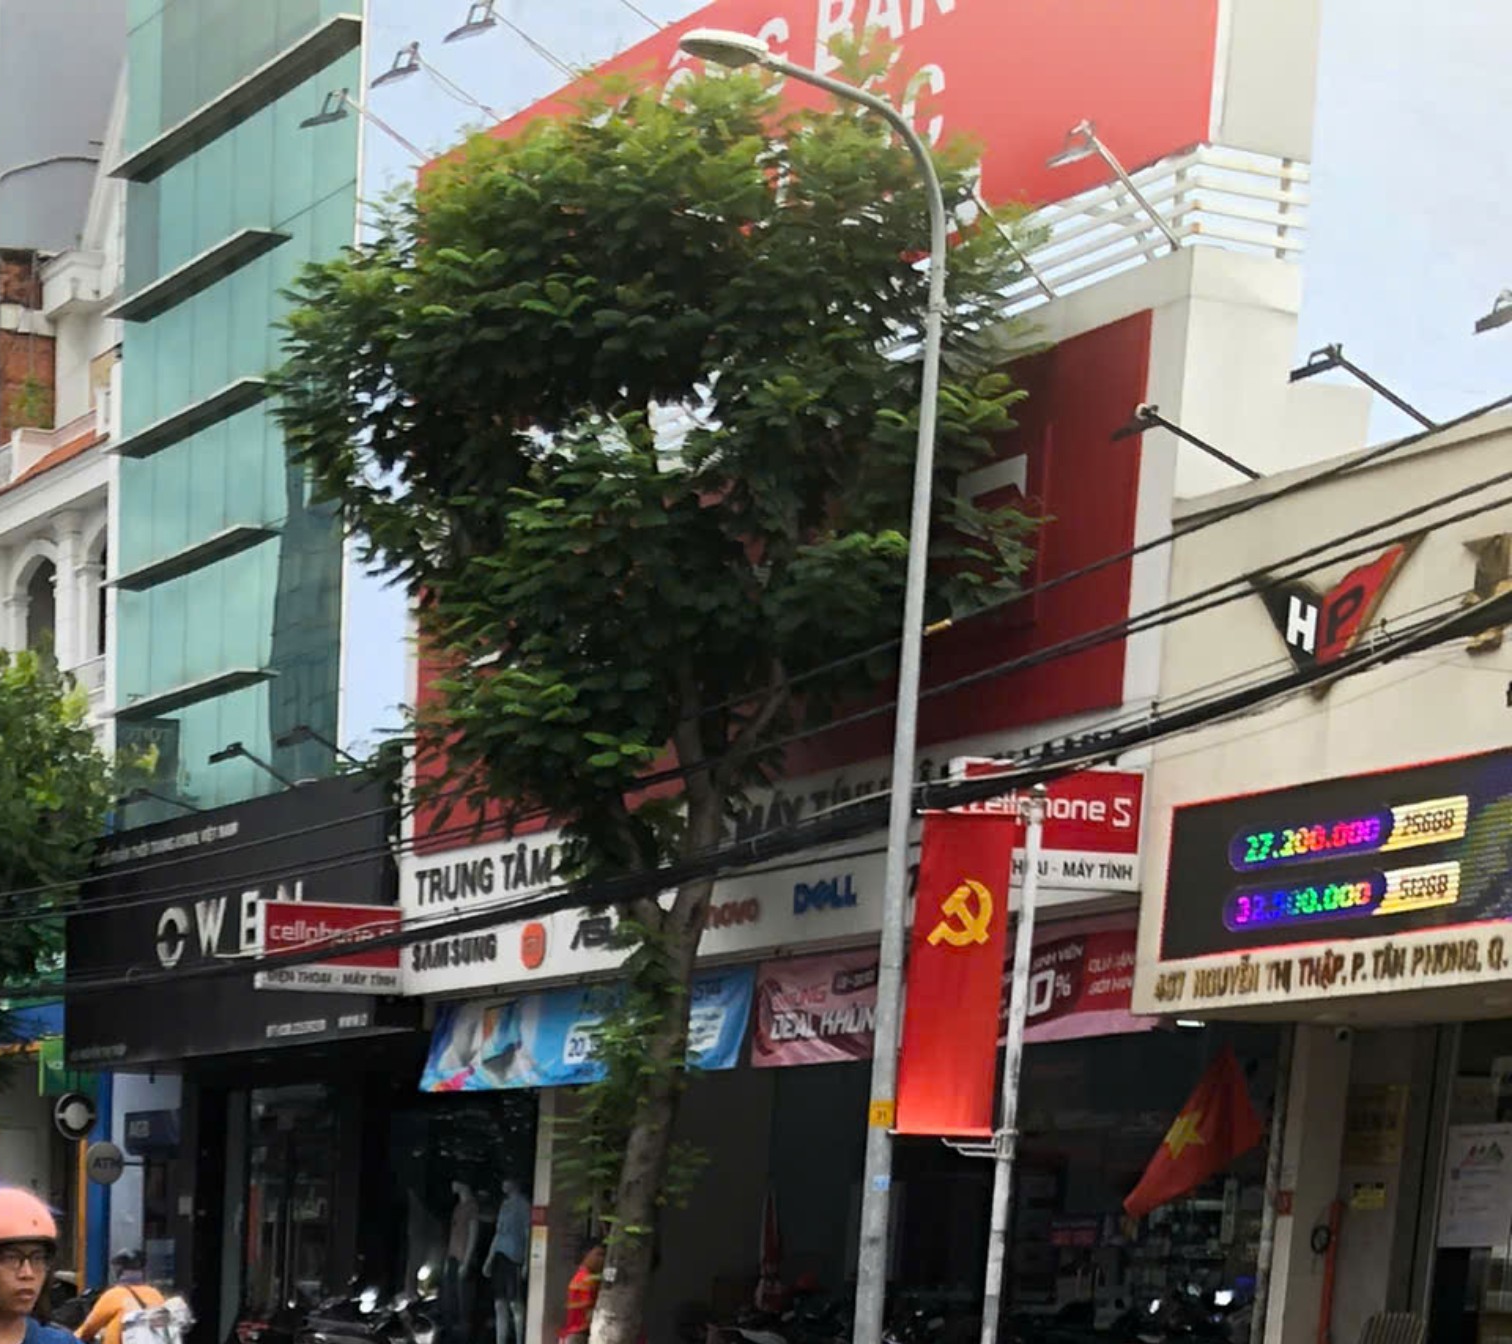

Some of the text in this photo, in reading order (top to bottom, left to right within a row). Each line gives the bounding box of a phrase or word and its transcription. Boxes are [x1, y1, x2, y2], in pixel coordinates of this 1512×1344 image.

[415, 843, 553, 905] TRUNG TÂM
[1062, 858, 1095, 878] MÁY
[1100, 861, 1133, 880] TÍNH
[793, 874, 858, 915] DELL
[157, 881, 303, 969] OWE
[412, 933, 498, 972] SAMSUNG
[1193, 953, 1260, 1000] NGUYỄN
[1351, 951, 1367, 982] P.
